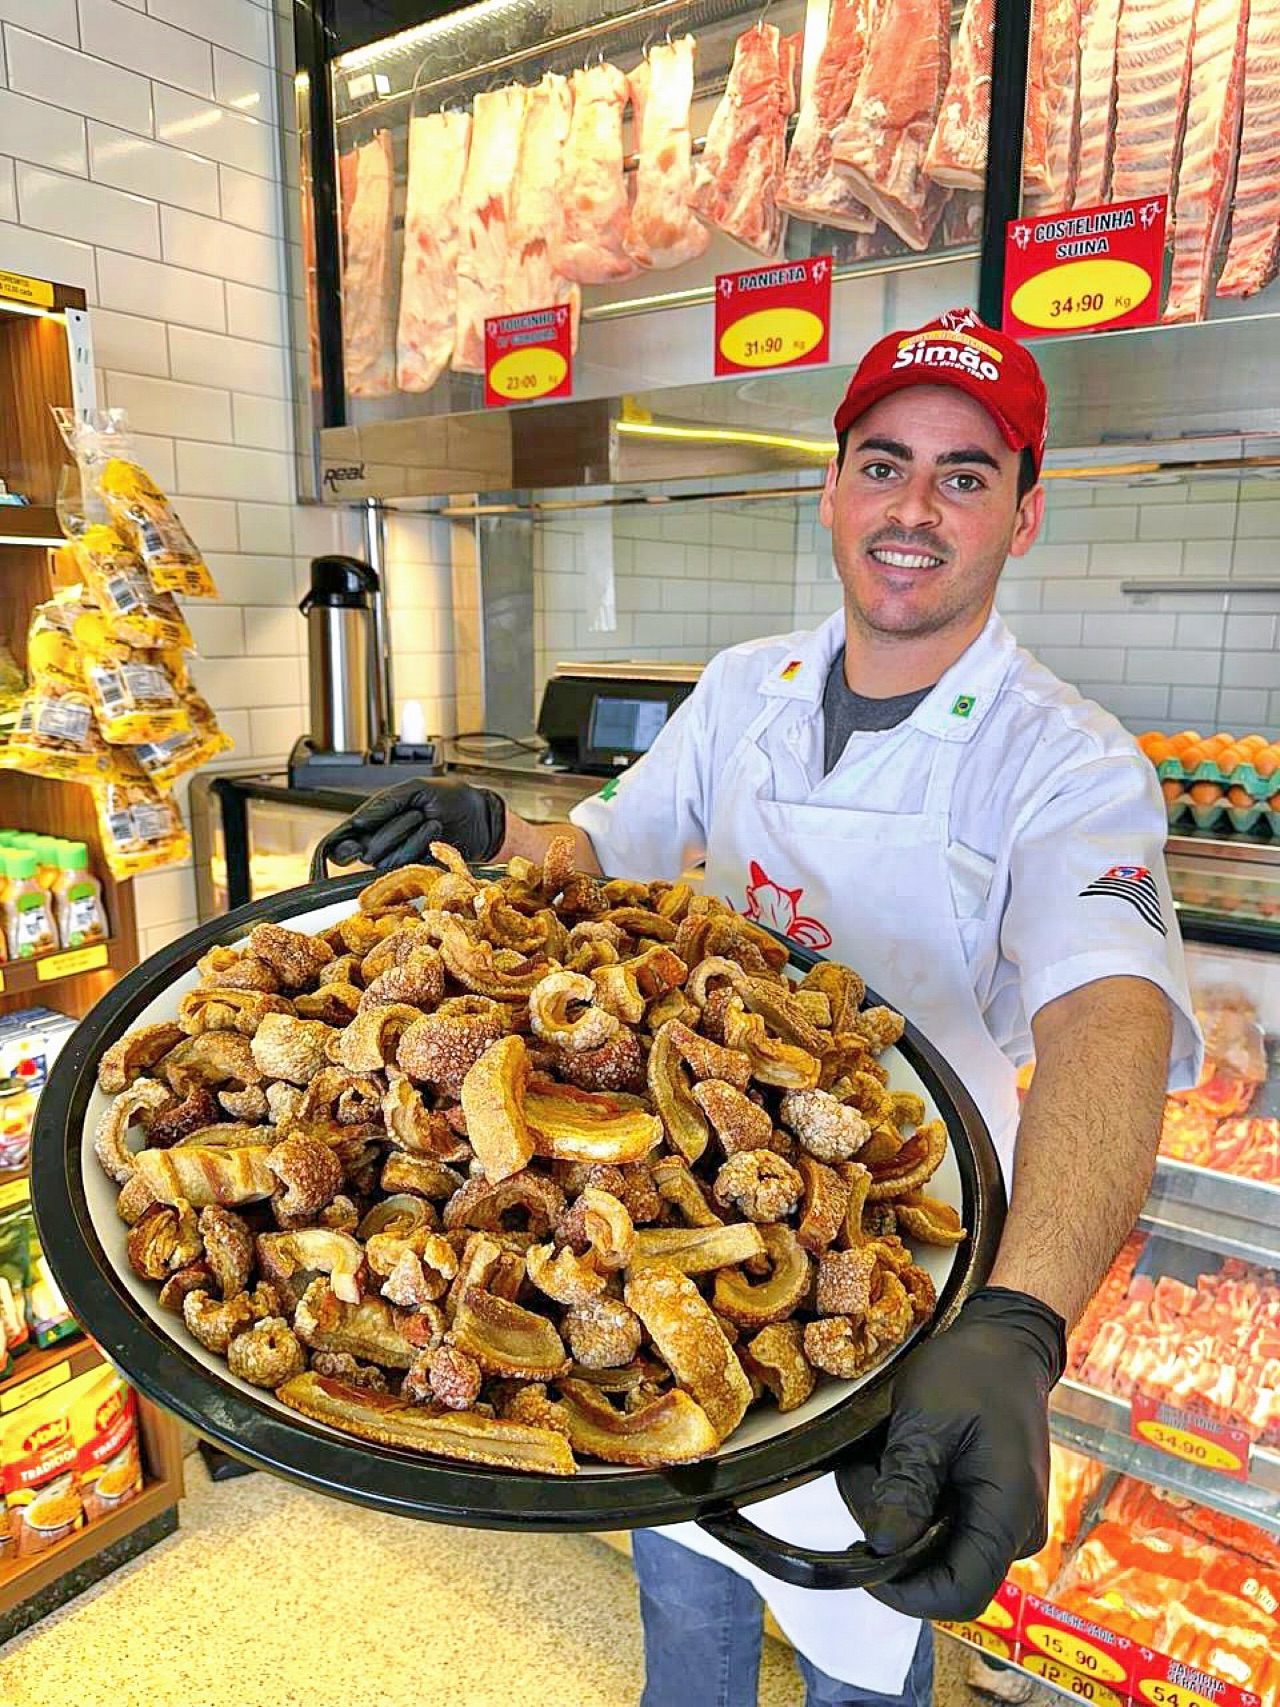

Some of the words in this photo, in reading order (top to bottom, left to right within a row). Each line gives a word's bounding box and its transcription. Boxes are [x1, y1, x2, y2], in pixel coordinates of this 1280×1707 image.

[1035, 207, 1135, 243] COSTELINHA
[1056, 237, 1109, 261] SUINA
[738, 265, 806, 292] PANCETA
[1050, 293, 1104, 317] 34,90
[1114, 296, 1131, 309] Kg
[892, 340, 999, 381] Simão
[324, 463, 365, 493] Real
